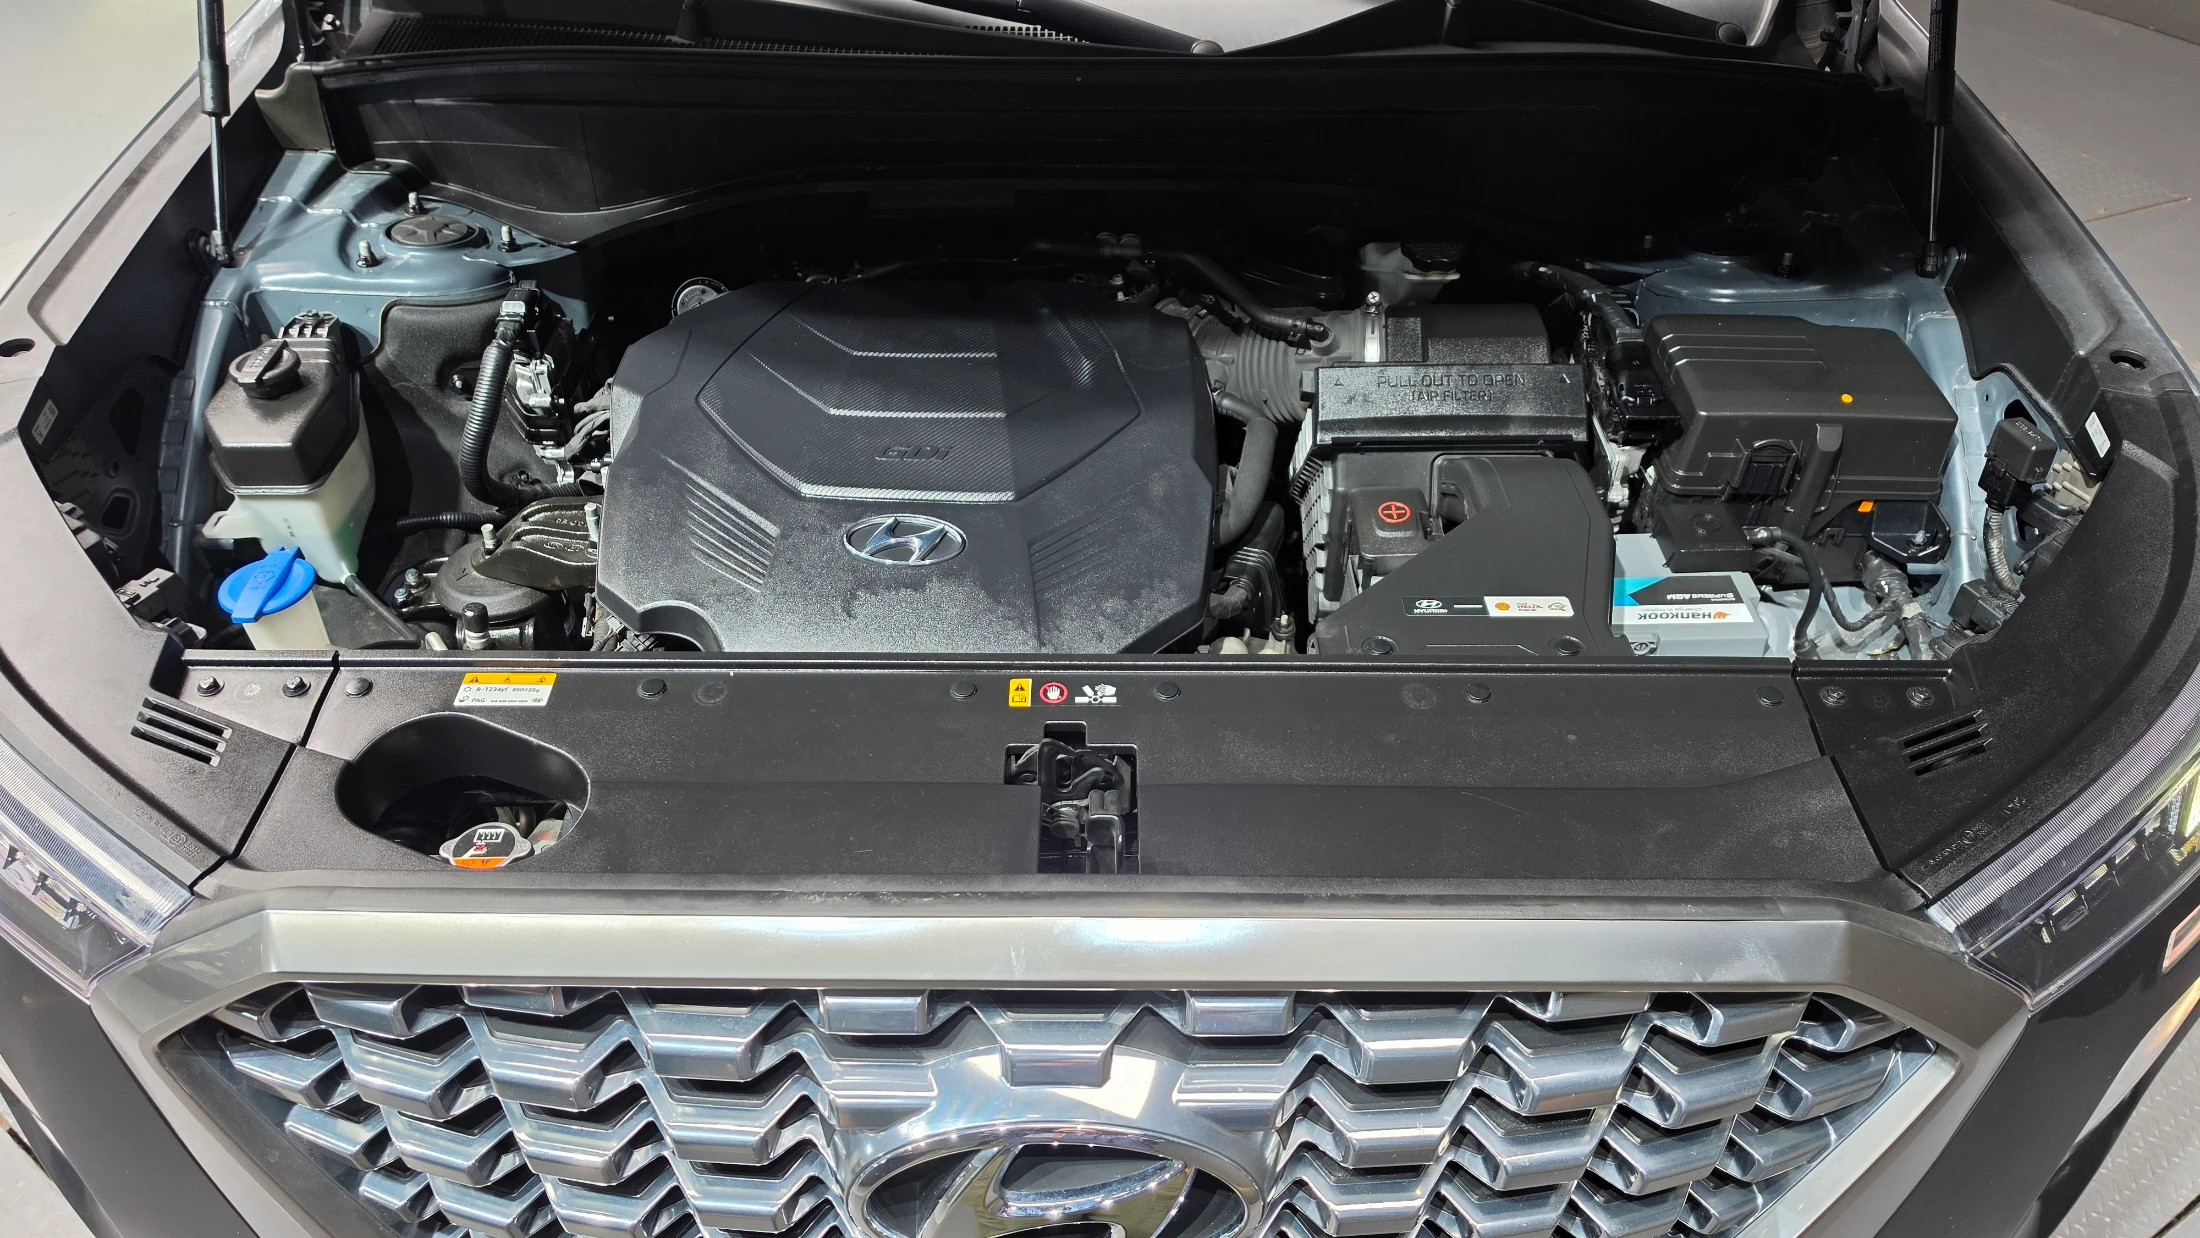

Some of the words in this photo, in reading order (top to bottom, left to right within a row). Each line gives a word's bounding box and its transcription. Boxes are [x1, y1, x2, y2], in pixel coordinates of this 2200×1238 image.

[1377, 375, 1417, 388] PULL
[1421, 374, 1453, 387] OUT
[1458, 374, 1478, 387] TO
[1483, 373, 1526, 386] OPEN
